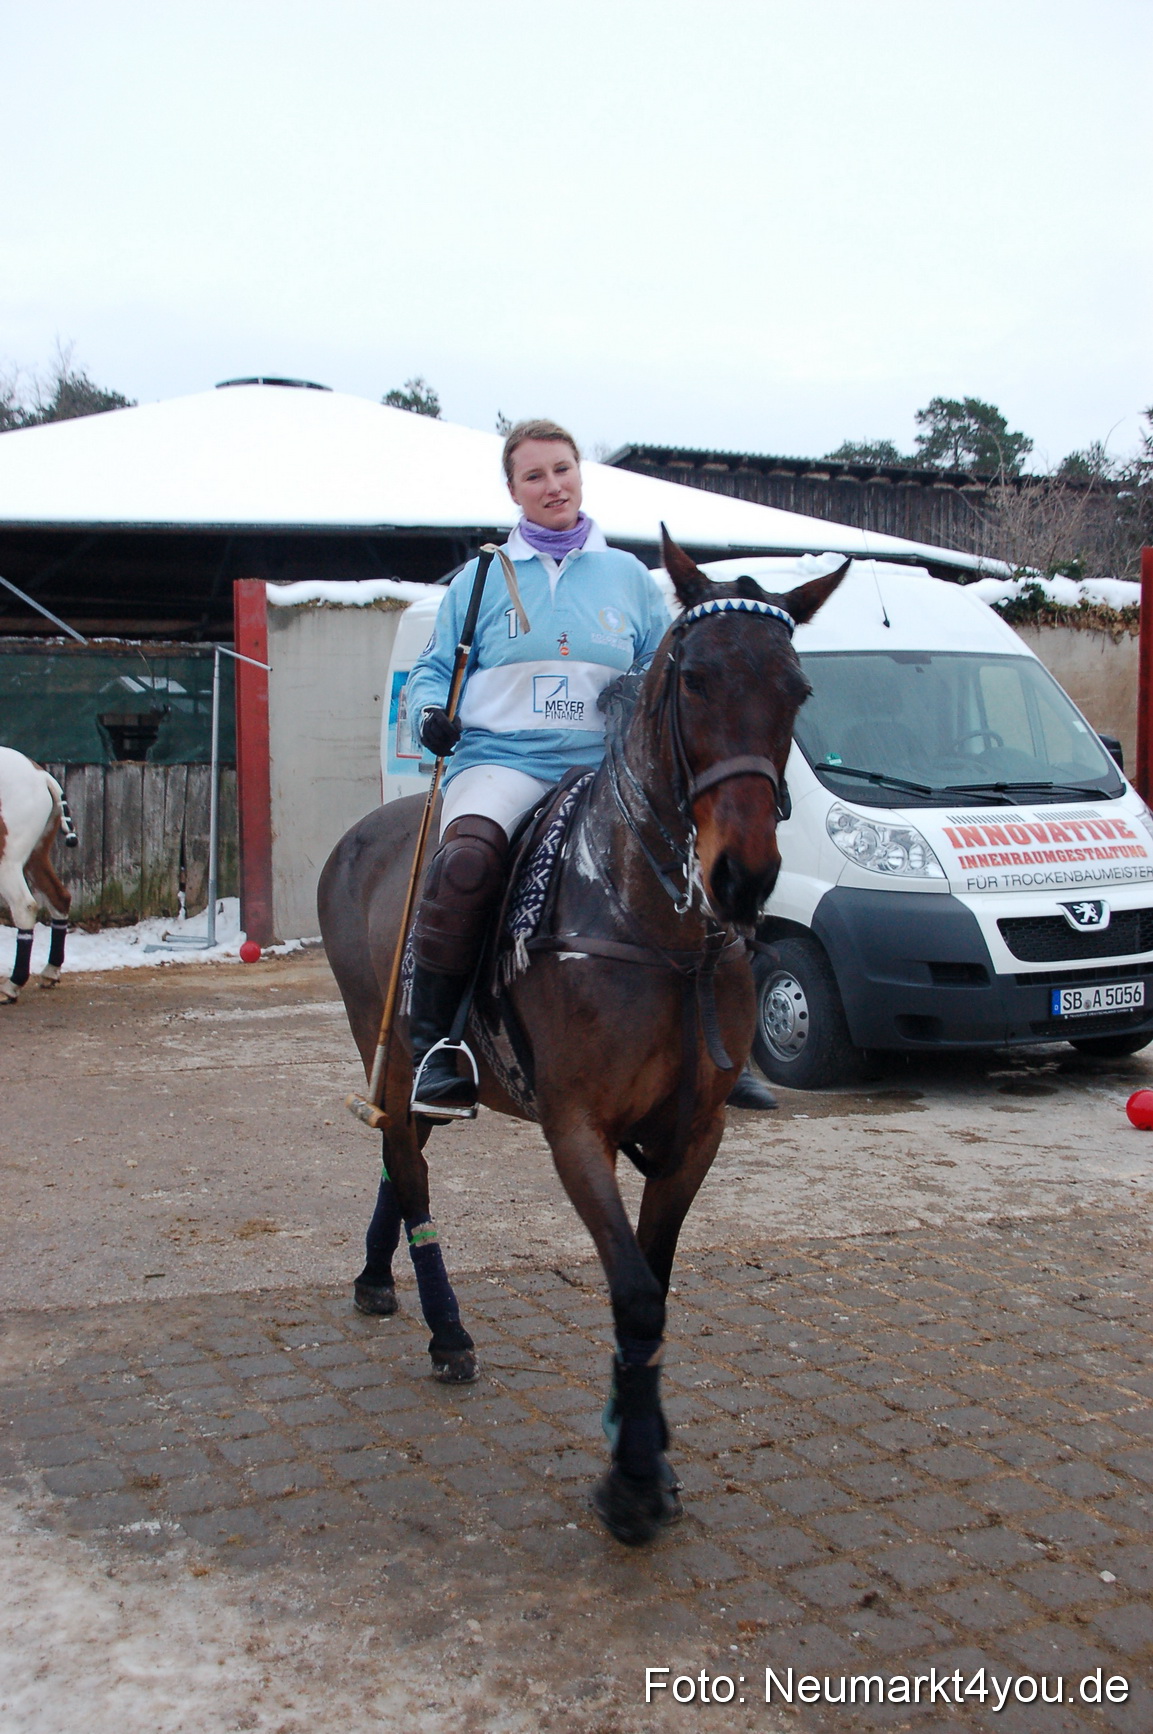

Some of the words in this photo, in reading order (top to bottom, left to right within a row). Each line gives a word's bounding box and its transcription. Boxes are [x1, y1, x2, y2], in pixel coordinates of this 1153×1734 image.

[505, 608, 517, 638] 1
[545, 700, 584, 713] MEYER
[545, 710, 584, 720] FINANCE
[942, 819, 1137, 849] INNOVATIVE
[958, 845, 1148, 869] INNENRAUMGESTALTUNG
[967, 875, 998, 890] FÜR
[1001, 866, 1153, 887] TROCKENBAUMEISTER
[1063, 992, 1082, 1011] SB
[1093, 990, 1102, 1008] A
[1106, 985, 1142, 1006] 5056
